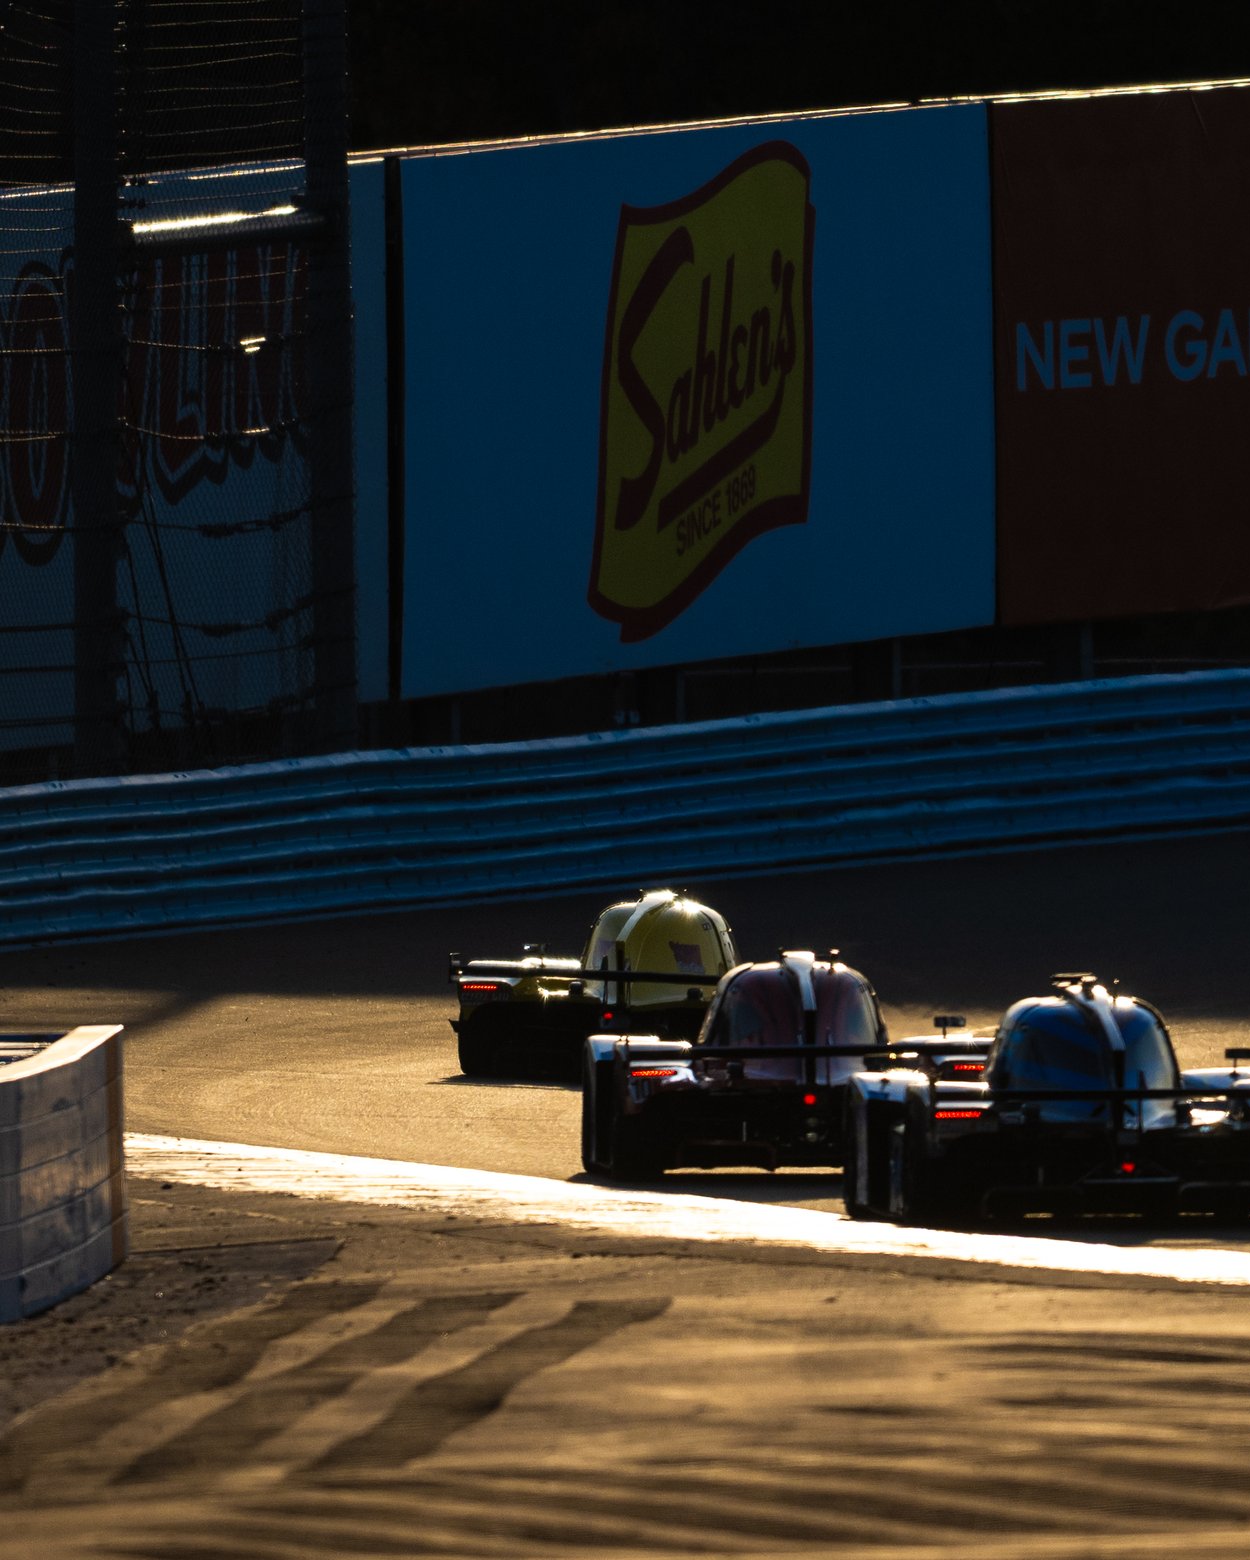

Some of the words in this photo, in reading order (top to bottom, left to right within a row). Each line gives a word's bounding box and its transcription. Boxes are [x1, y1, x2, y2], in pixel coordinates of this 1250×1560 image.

[614, 225, 797, 533] Sahlen's
[1015, 313, 1151, 392] NEW
[675, 490, 723, 557] SINCE
[724, 463, 758, 518] 1869
